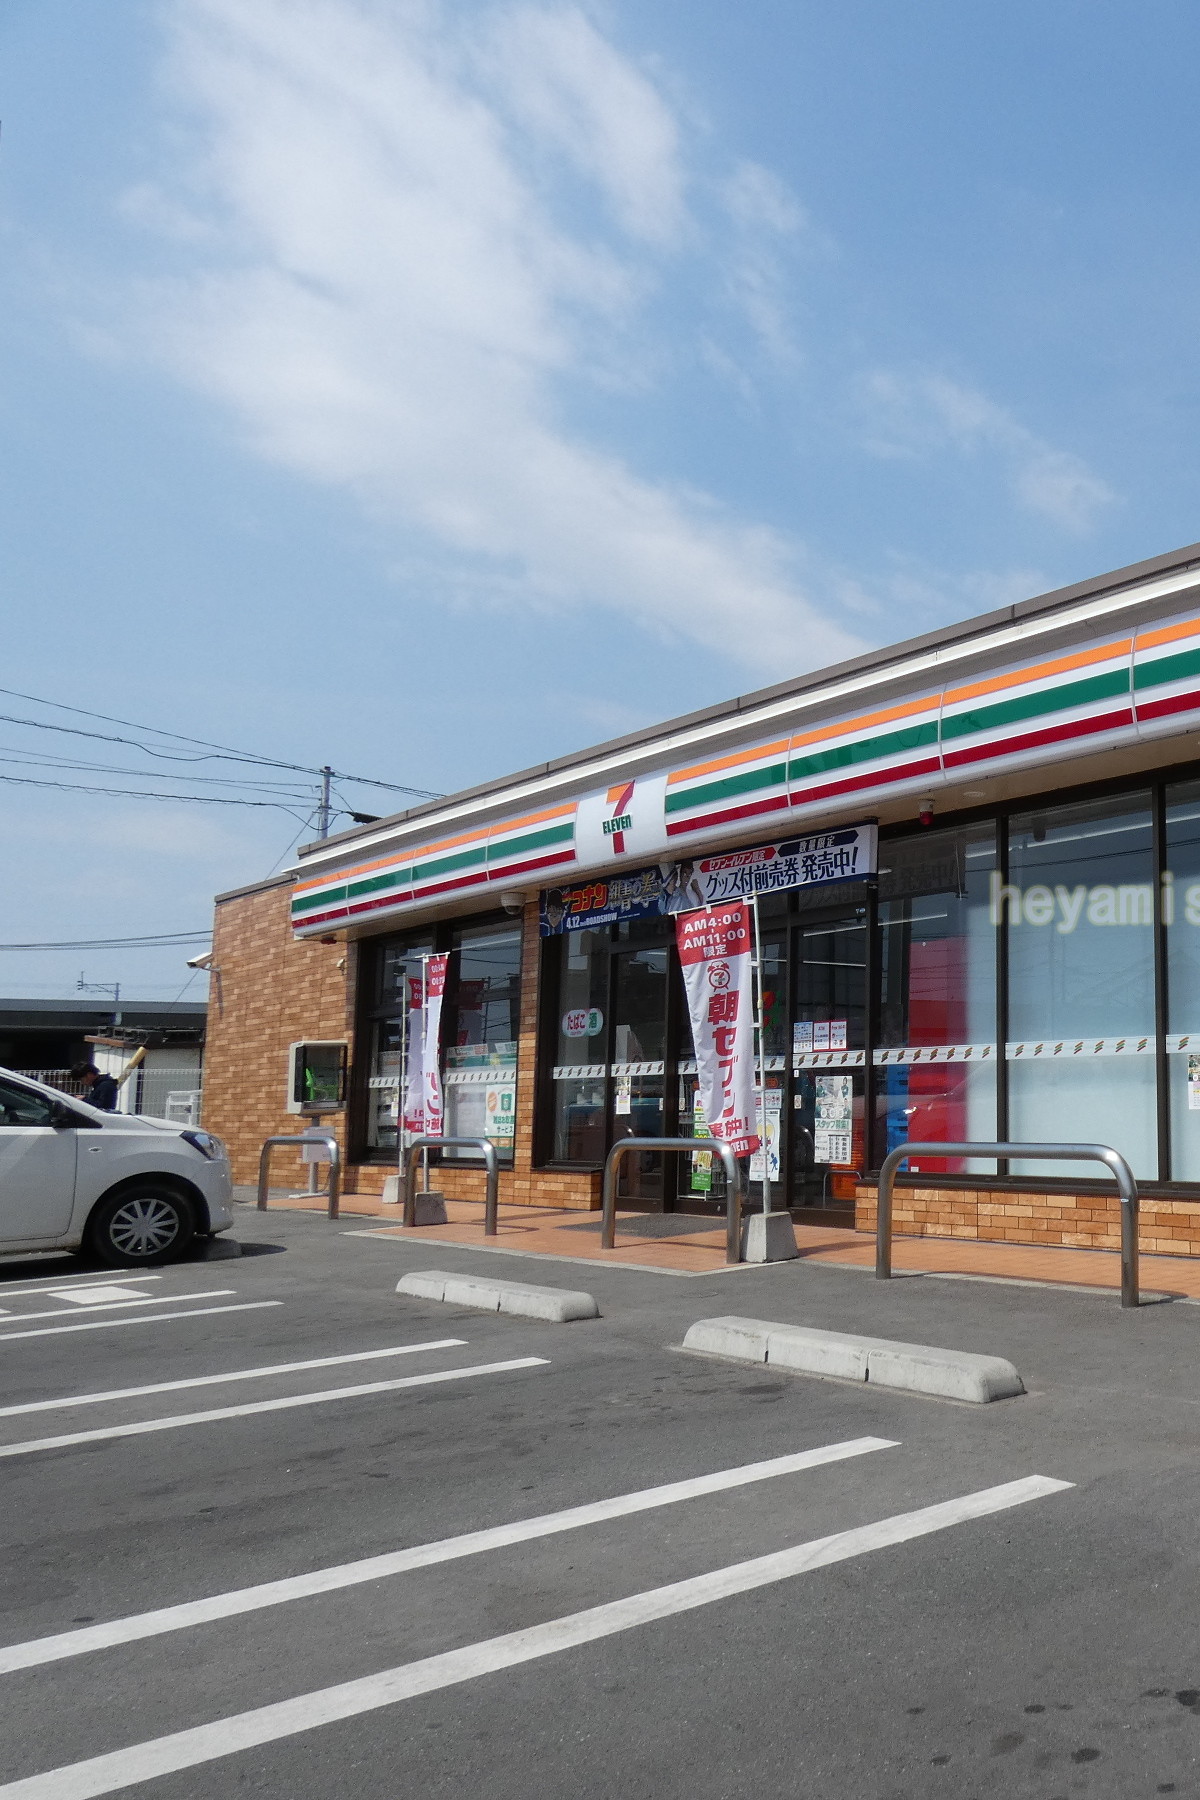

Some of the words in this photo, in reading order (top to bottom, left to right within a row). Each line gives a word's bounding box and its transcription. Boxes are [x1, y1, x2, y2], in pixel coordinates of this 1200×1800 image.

[799, 835, 835, 853] 数量限定
[684, 912, 742, 934] AM4:00
[683, 928, 746, 951] AM11:00
[703, 944, 728, 958] 限定
[708, 990, 740, 1119] 朝セブン
